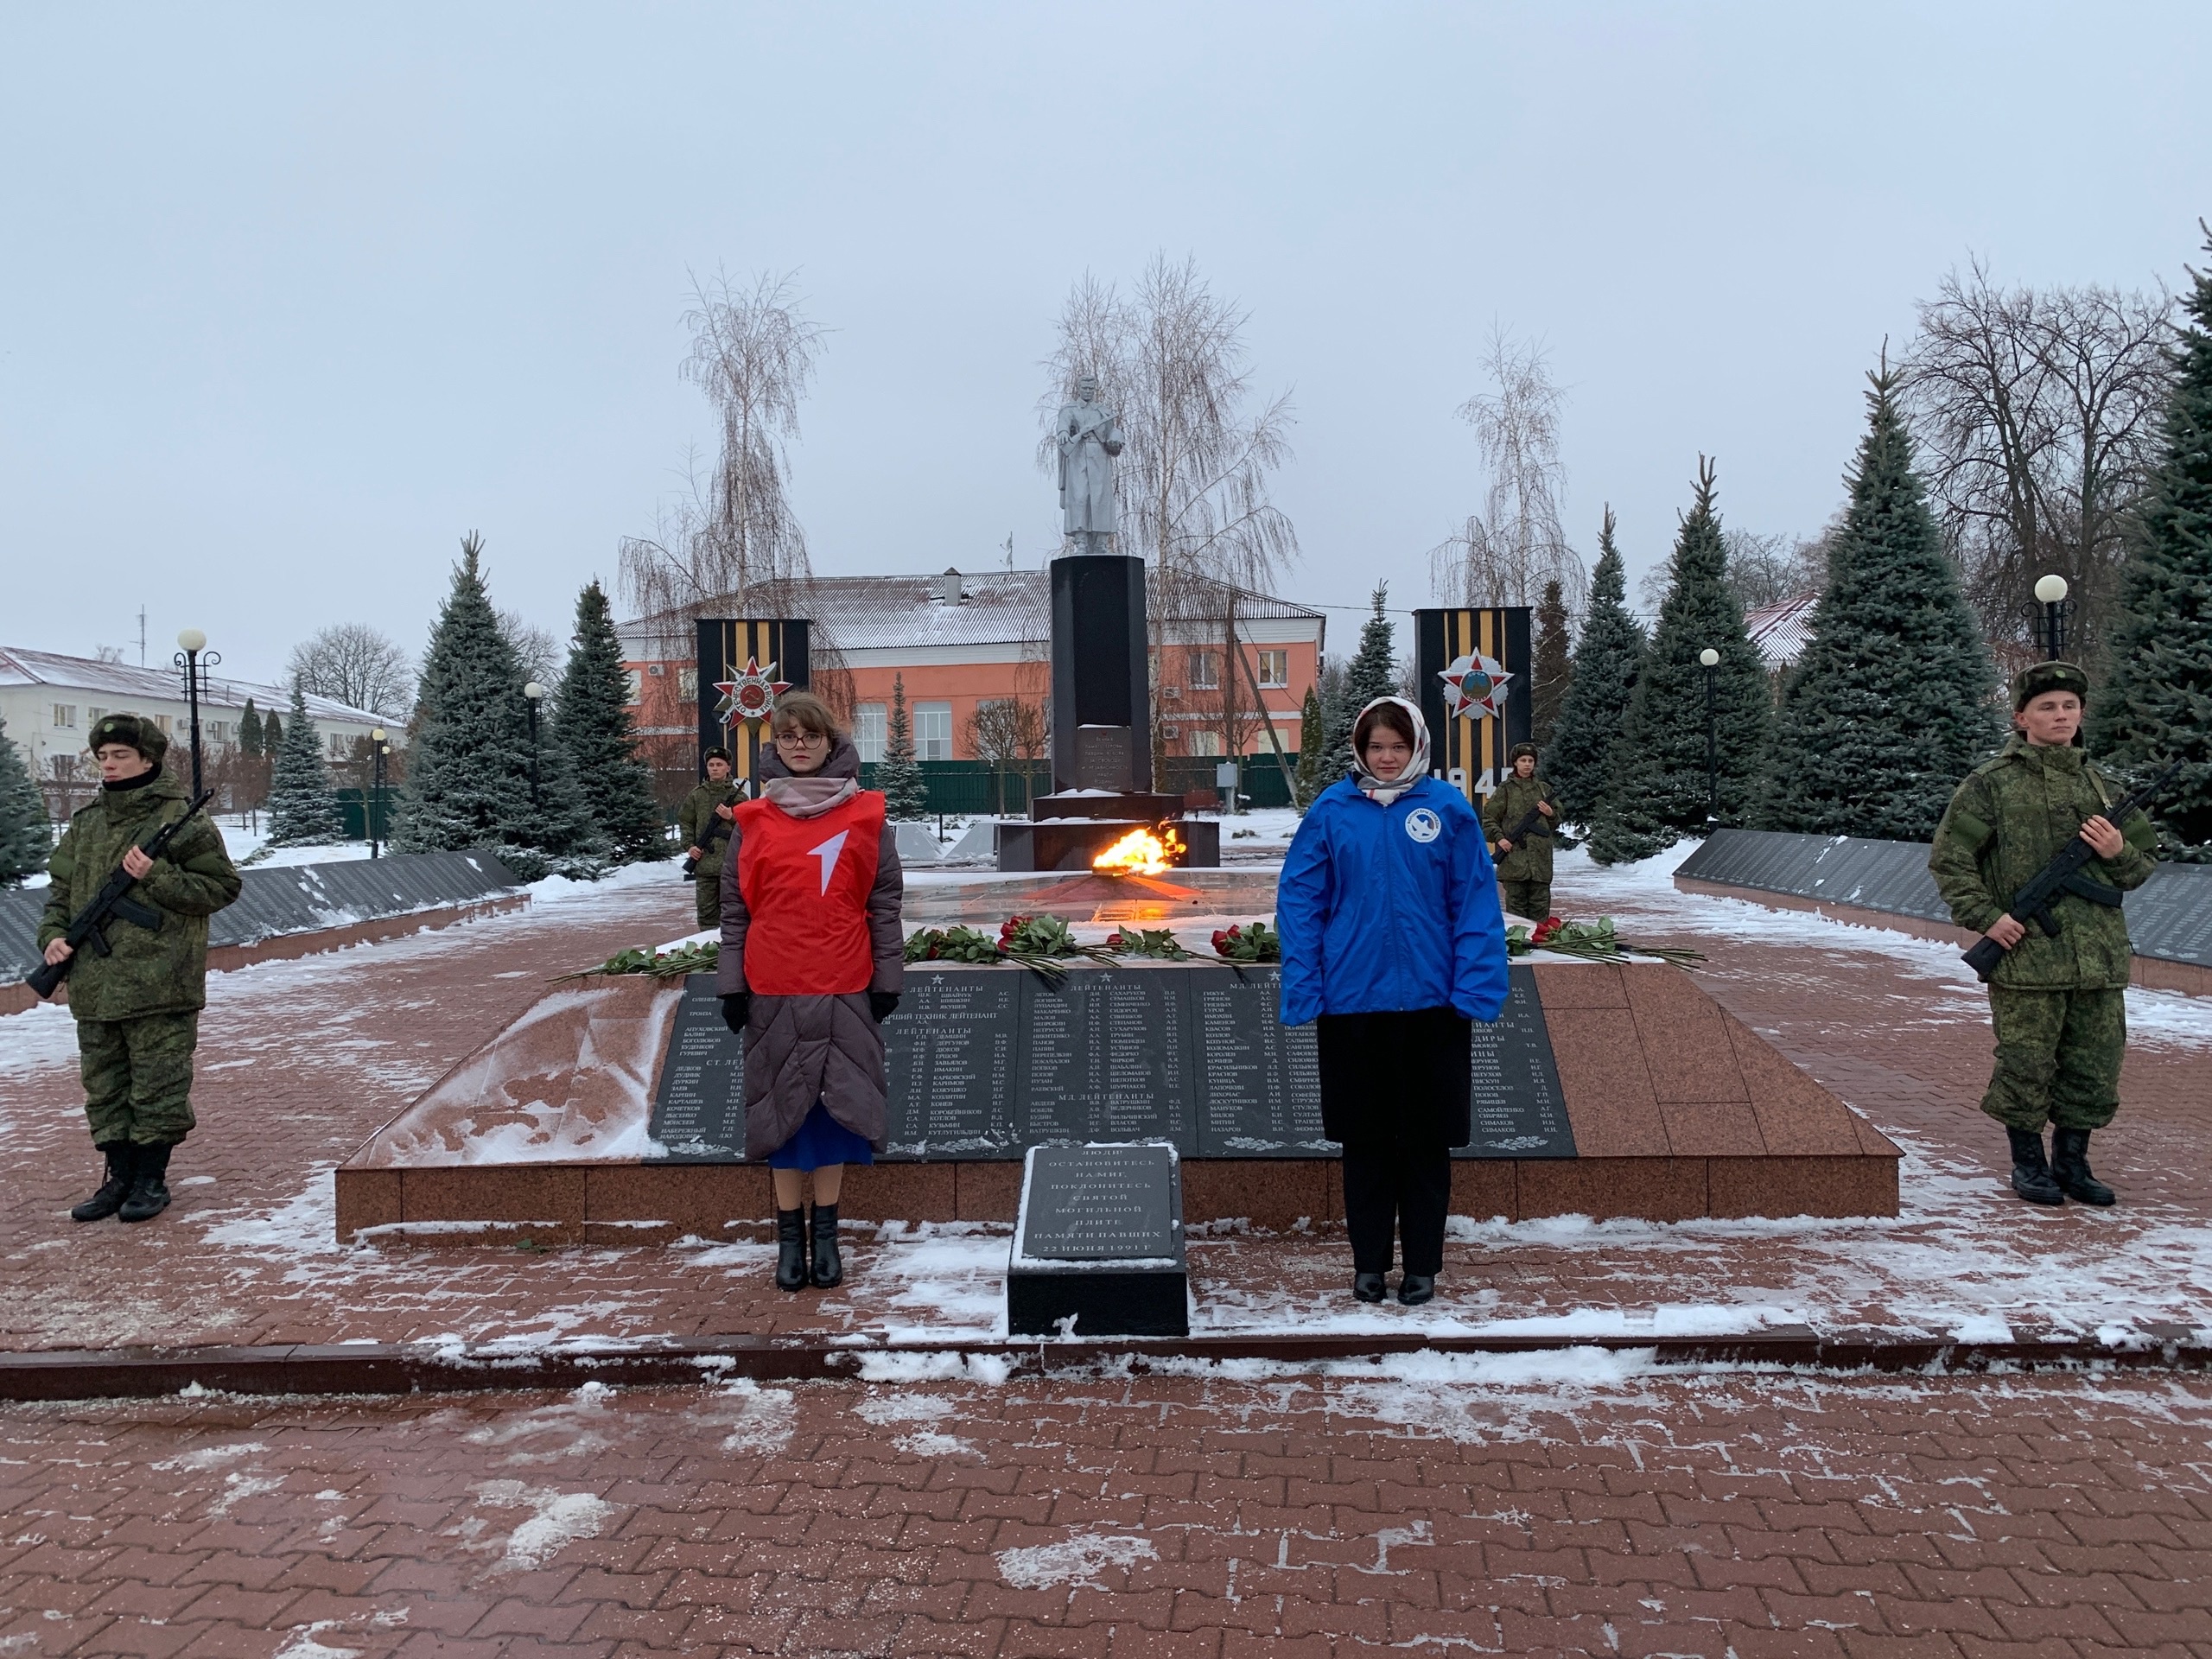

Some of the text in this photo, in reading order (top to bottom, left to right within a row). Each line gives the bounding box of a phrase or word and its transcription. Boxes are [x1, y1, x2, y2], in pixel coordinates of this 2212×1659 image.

[733, 677, 770, 714] ОТЕЧЕСТВЕННАЯ
[1070, 983, 1141, 992] ЛЕЙТЕНАНТЫ
[895, 1027, 971, 1035] ЛЕЙТЕНАНТЫ
[1072, 1193, 1128, 1202] СВЯТОЙ
[1055, 1205, 1141, 1214] МОГИЛЬНОЙ
